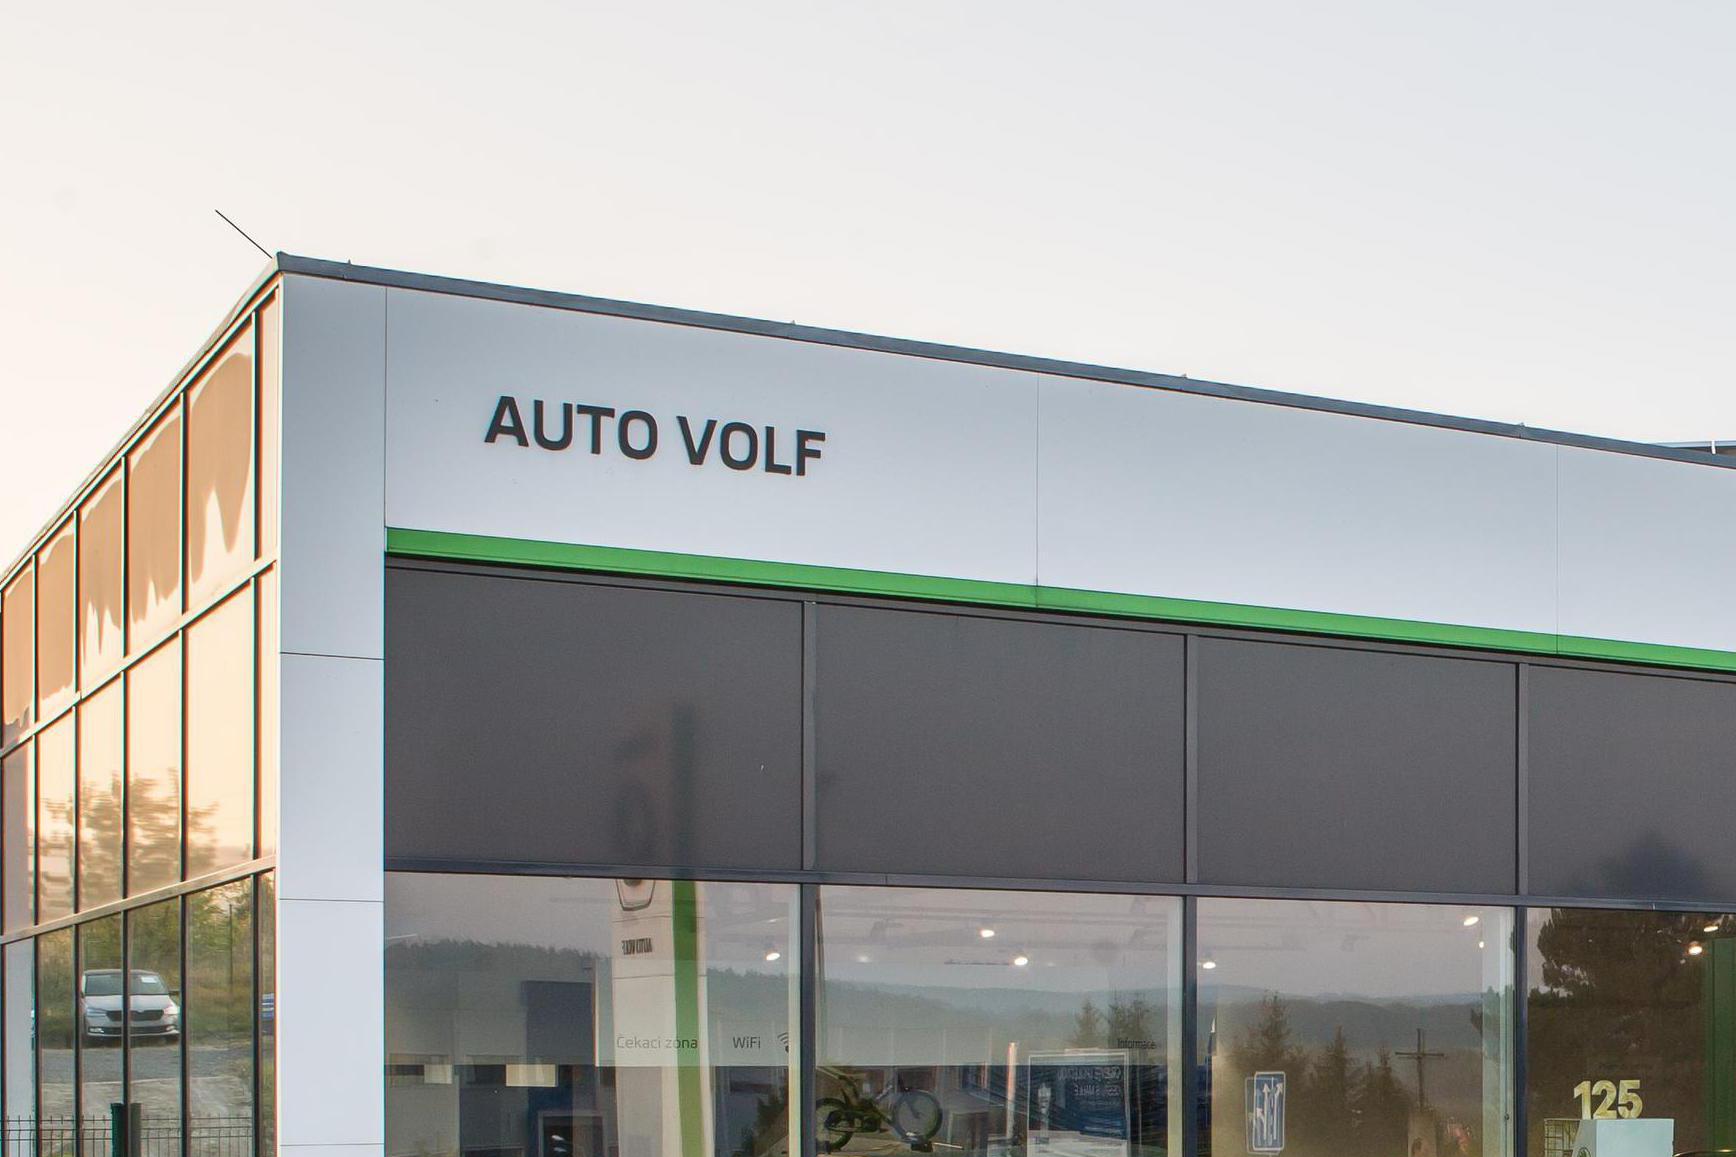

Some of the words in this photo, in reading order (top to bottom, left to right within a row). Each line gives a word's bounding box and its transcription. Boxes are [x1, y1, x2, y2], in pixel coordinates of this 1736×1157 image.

[484, 395, 658, 460] AUTO
[677, 415, 827, 477] VOLF
[732, 1035, 761, 1049] WiFi
[1574, 1079, 1643, 1120] 125
